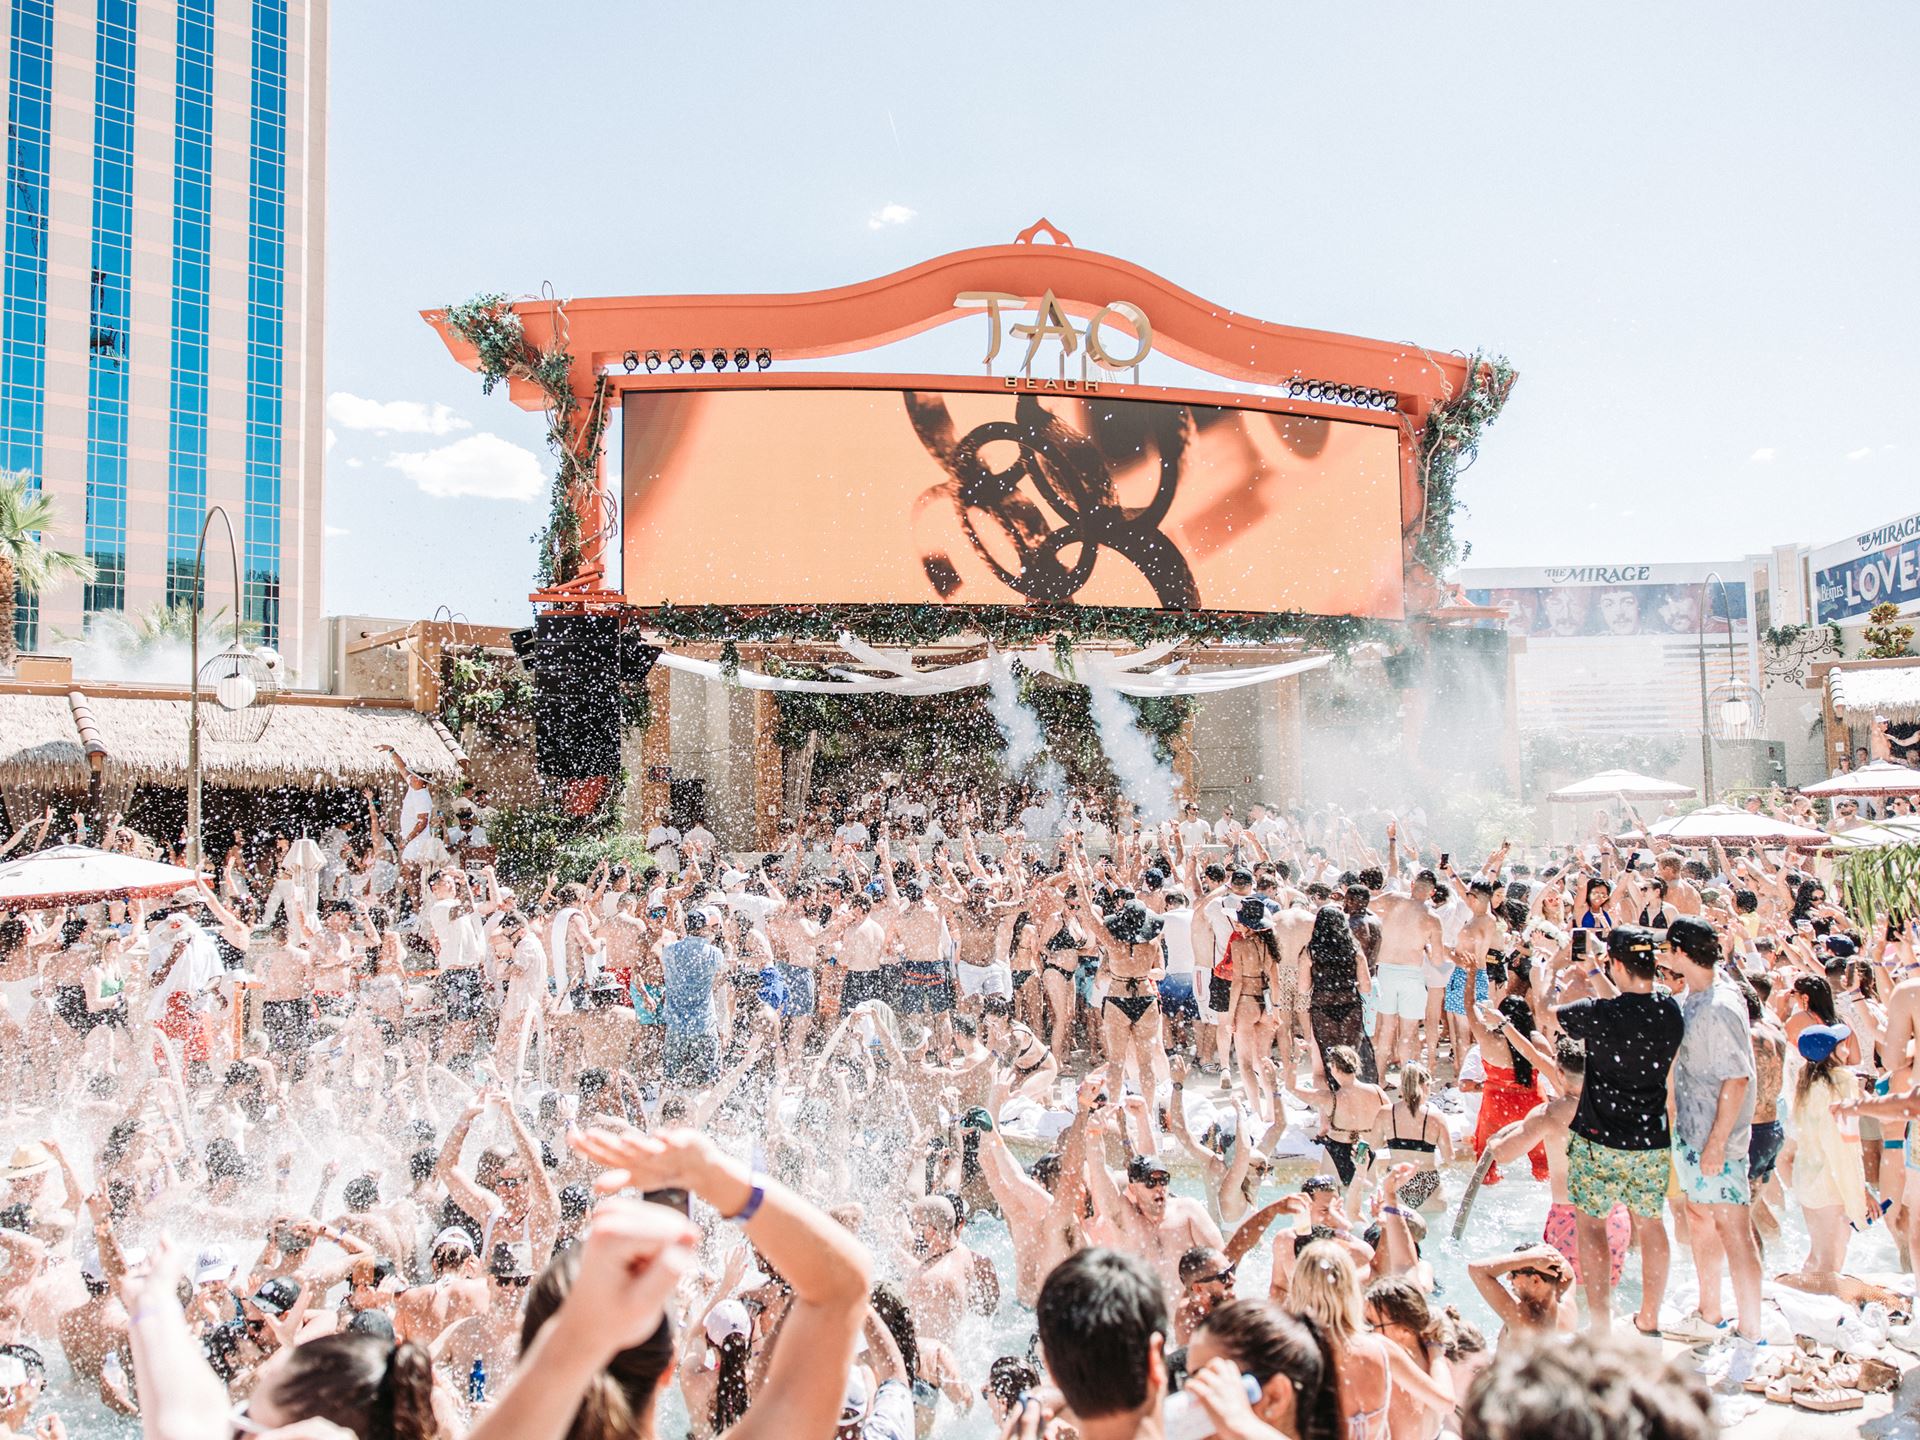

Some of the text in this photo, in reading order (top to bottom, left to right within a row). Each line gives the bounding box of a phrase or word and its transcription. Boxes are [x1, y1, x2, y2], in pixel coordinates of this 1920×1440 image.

[953, 288, 1153, 372] TAO
[1005, 376, 1098, 391] BEACH
[1862, 515, 1920, 551] MIRAGE
[1544, 566, 1650, 584] THE MIRAGE
[1845, 550, 1918, 607] LOVE
